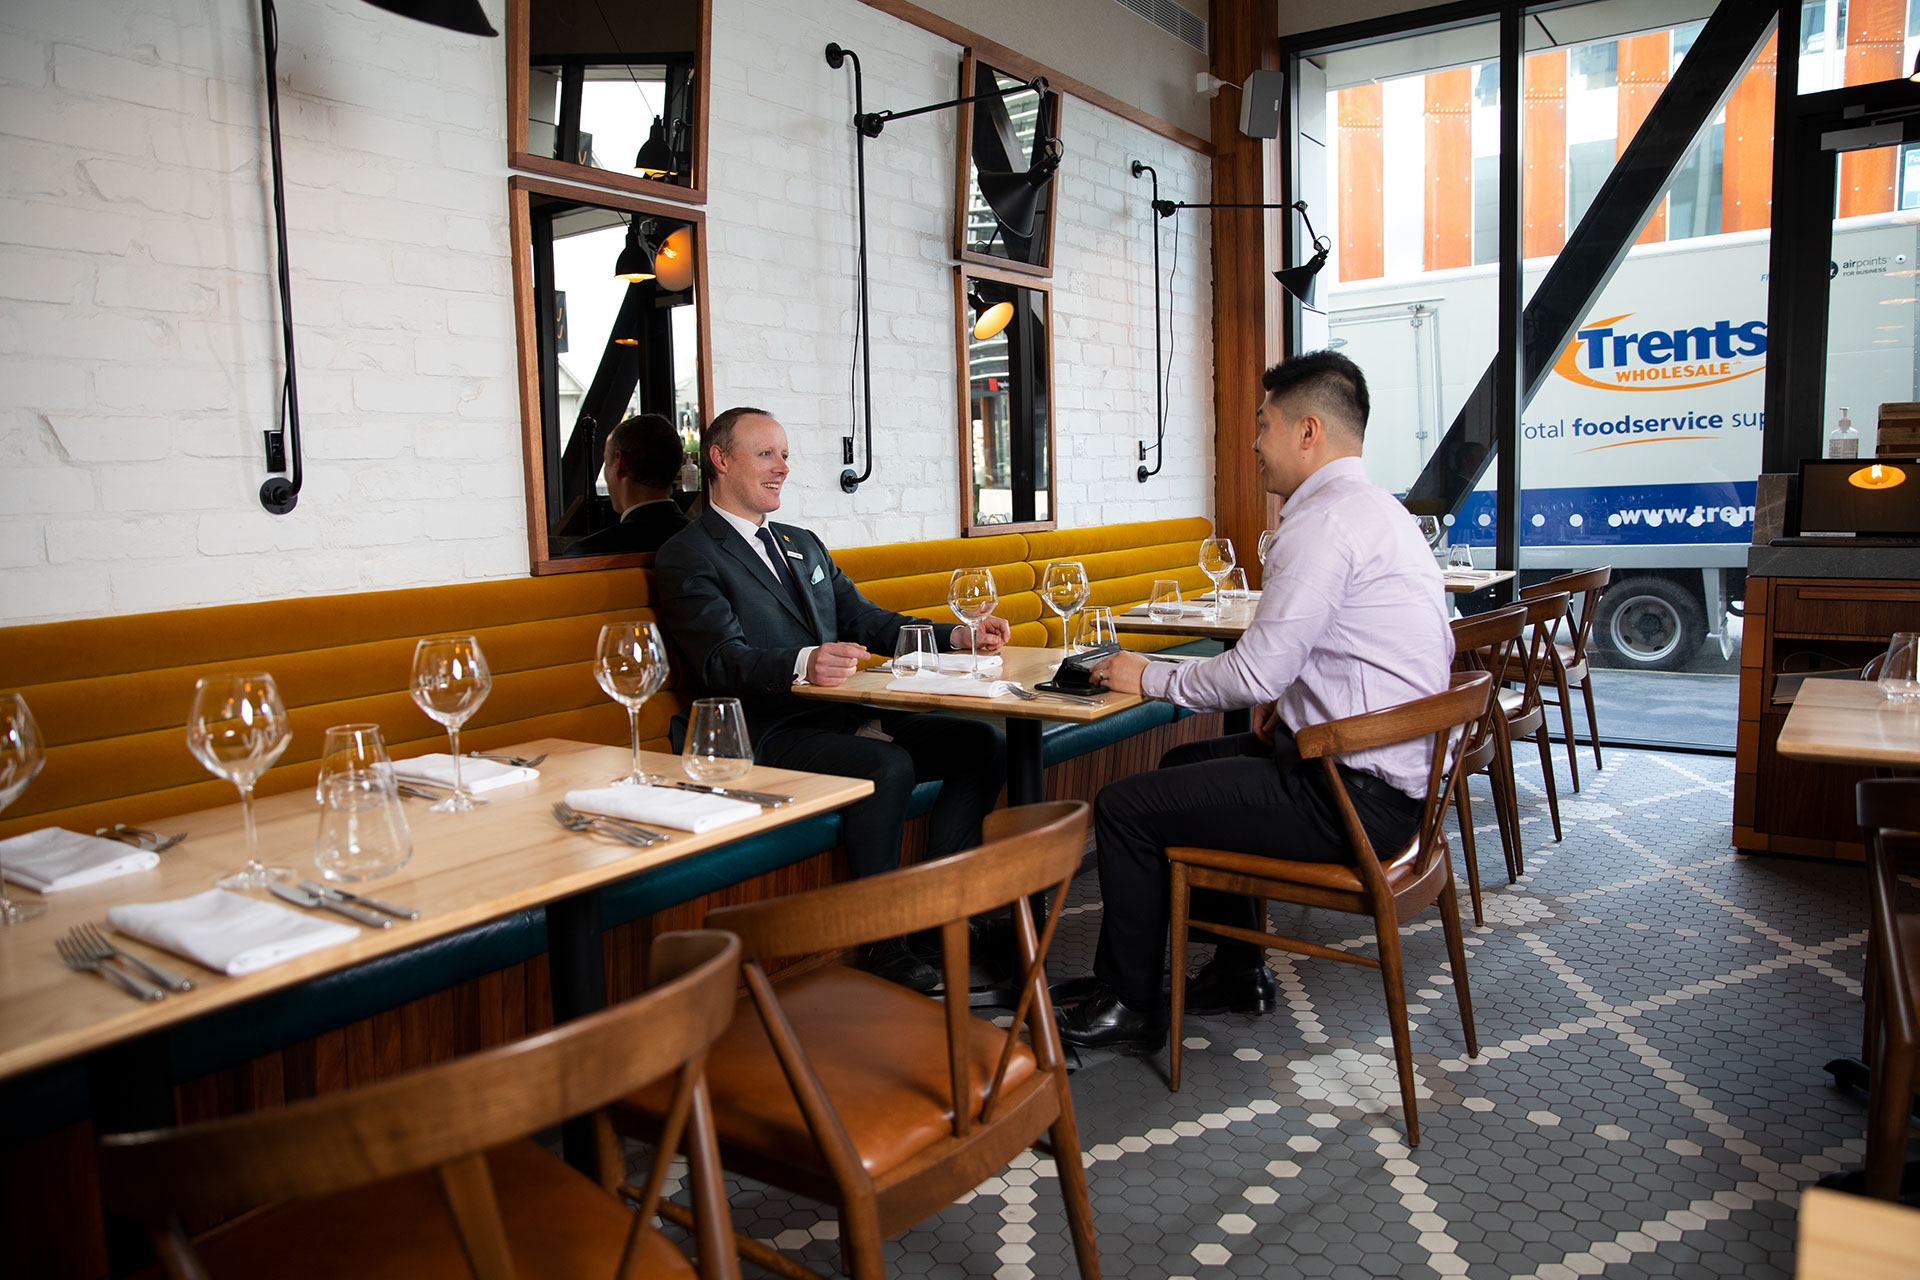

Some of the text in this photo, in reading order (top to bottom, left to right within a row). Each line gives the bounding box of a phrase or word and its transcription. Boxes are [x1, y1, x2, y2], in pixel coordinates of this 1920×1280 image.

[1842, 256, 1888, 269] airpoints
[1856, 267, 1887, 275] BUSINESS
[1577, 319, 1767, 369] Trents
[1616, 362, 1731, 382] WHOLESALE
[1521, 419, 1564, 440] otal
[1572, 411, 1723, 437] foodservice
